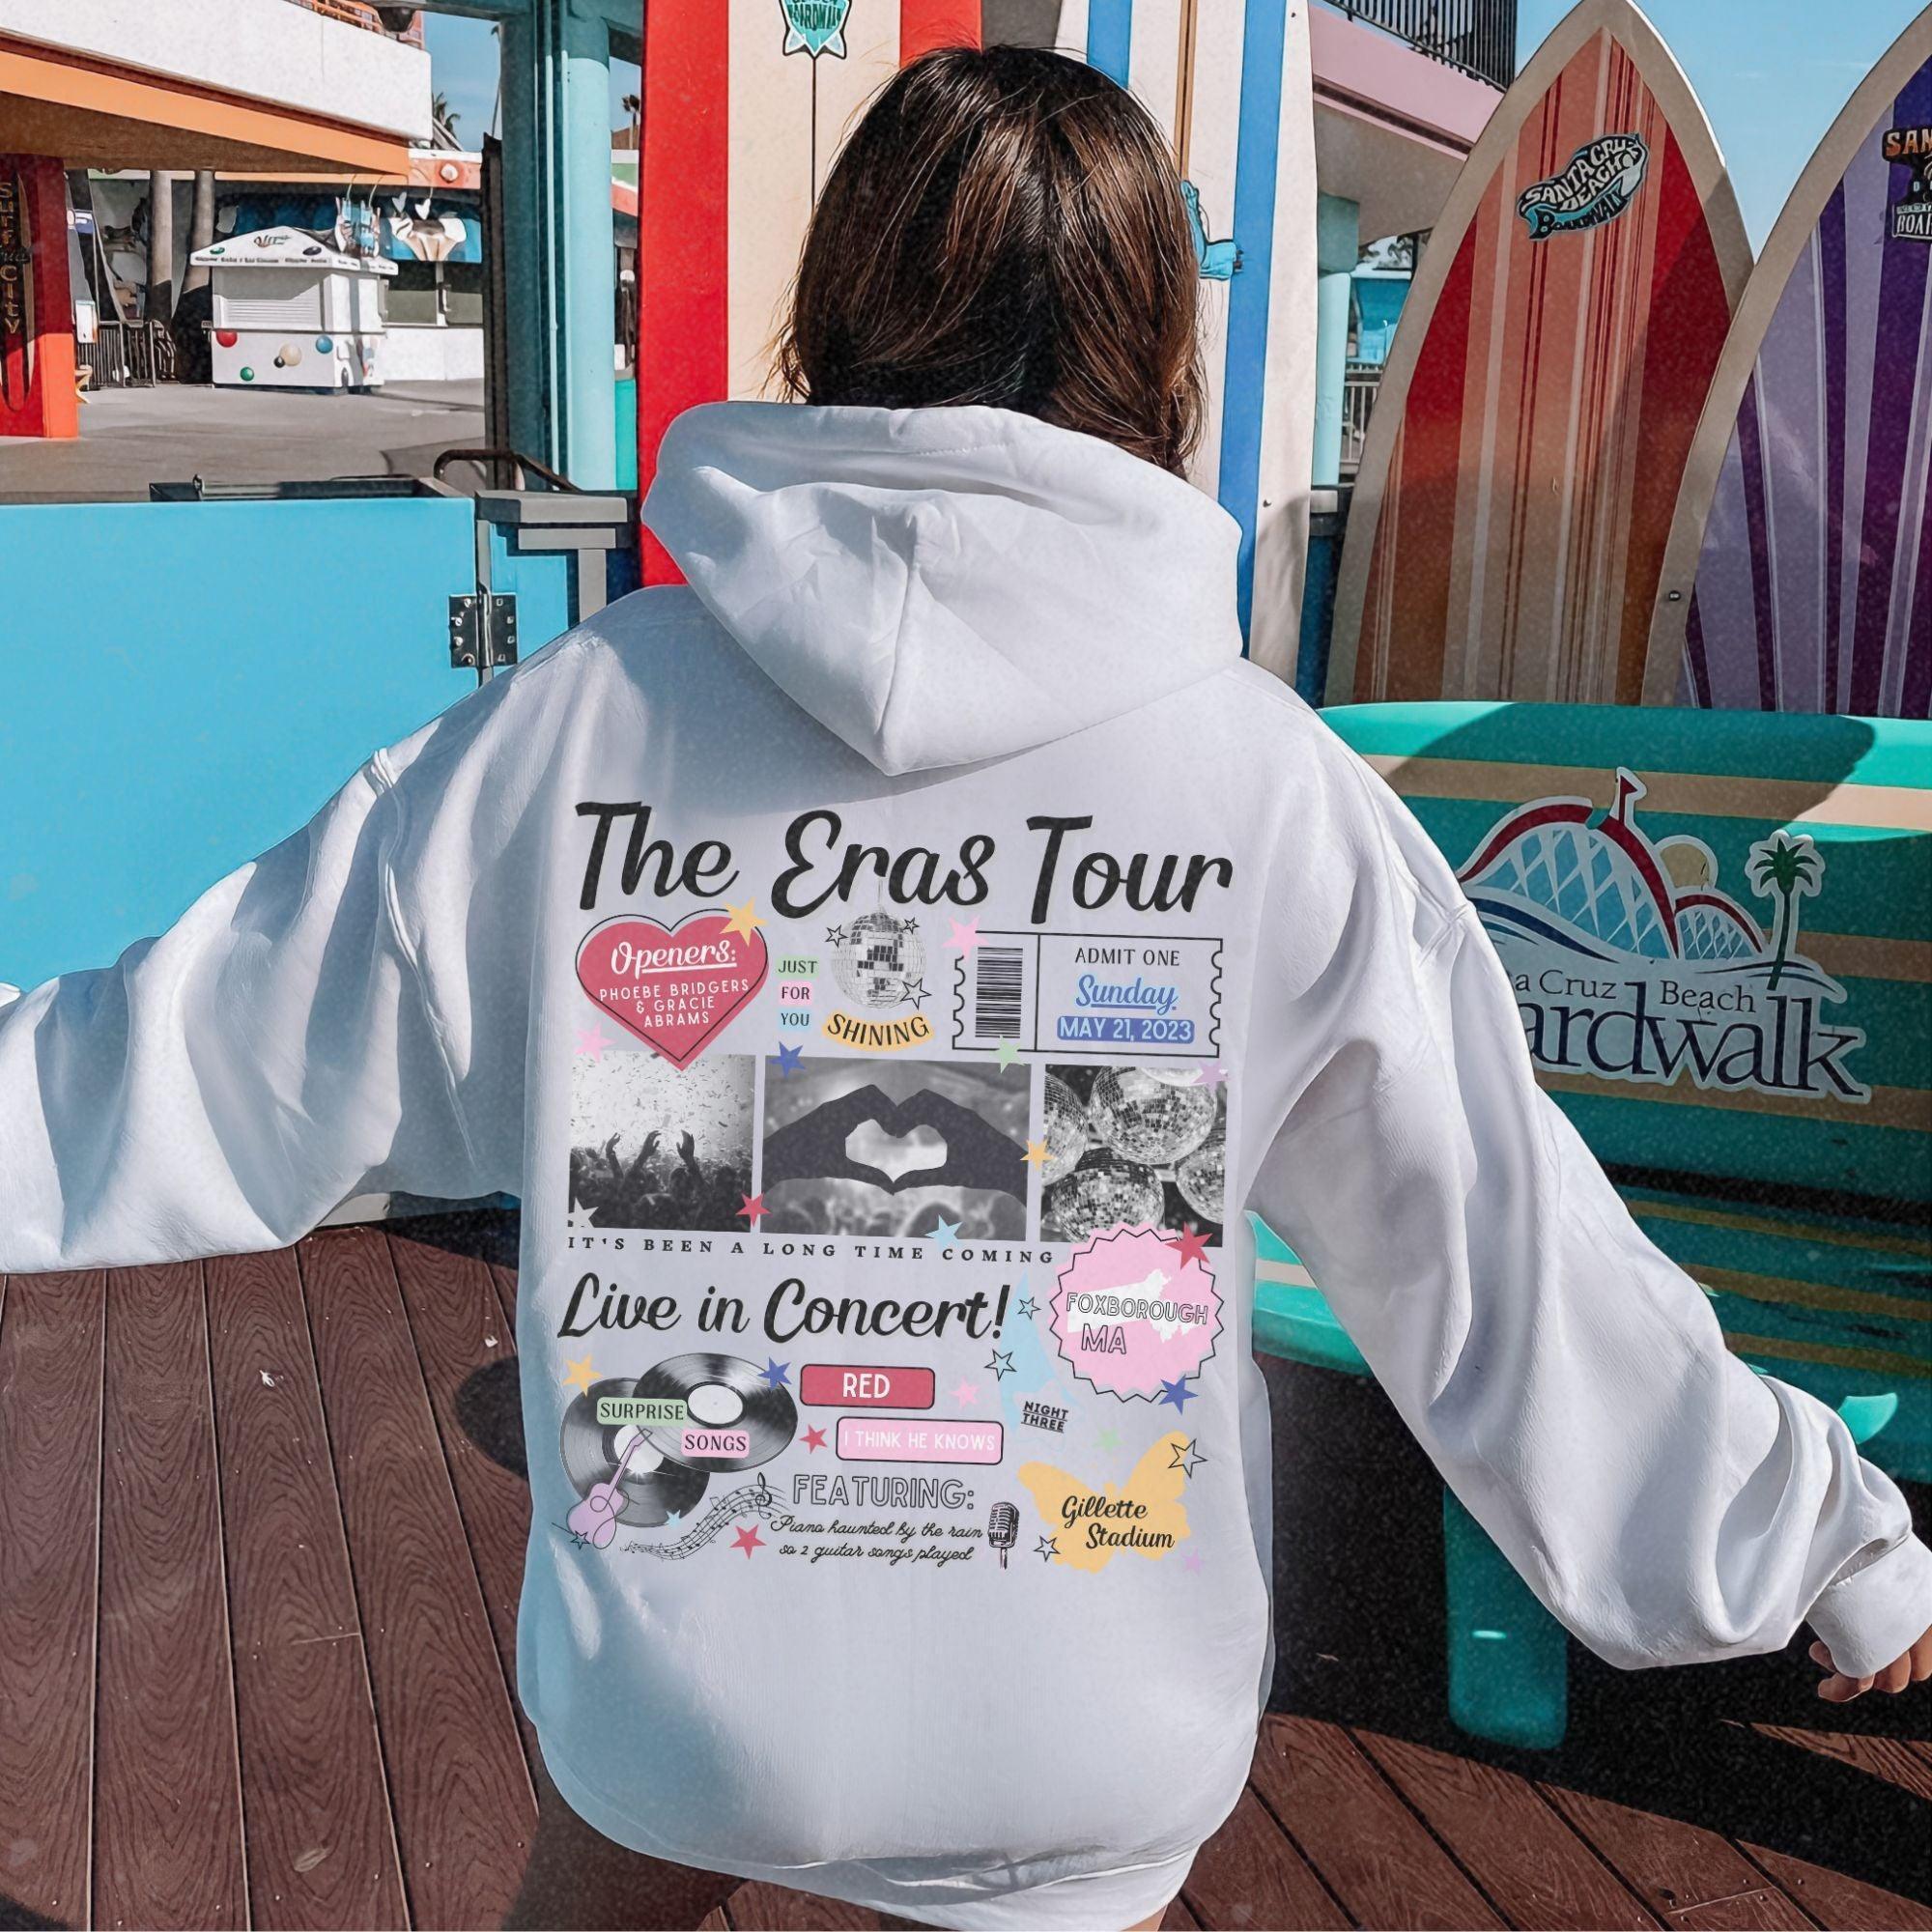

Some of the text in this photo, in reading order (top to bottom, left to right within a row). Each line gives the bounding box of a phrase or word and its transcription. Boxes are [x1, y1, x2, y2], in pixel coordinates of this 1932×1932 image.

[1521, 158, 1596, 212] SANTA
[575, 801, 1234, 924] The Eras Tour
[611, 939, 738, 980] Openers:
[778, 959, 817, 974] JUST
[1074, 948, 1180, 966] ADMIT ONE
[599, 979, 750, 1002] PHOEBE BRIDGERS
[781, 986, 810, 1001] FOR
[1075, 974, 1179, 1015] Sunday
[1539, 969, 1617, 1000] Cruz
[1661, 980, 1756, 1013] Beach
[636, 995, 715, 1014] & GRACIE
[643, 1011, 710, 1029] ABRAMS
[780, 1013, 810, 1027] YOU
[826, 1013, 929, 1047] SHINING
[1059, 1017, 1192, 1042] MAY 21, 2023
[568, 1236, 1053, 1264] IT'S BEEN A LONG TIME COMING
[557, 1272, 1010, 1344] Live in Concert!
[1066, 1293, 1208, 1325] FOXBOROUGH
[1081, 1323, 1127, 1354] MA
[842, 1373, 891, 1399] RED
[600, 1403, 685, 1420] SURPRISE
[1021, 1413, 1065, 1434] THREE
[1023, 1401, 1069, 1420] NIGHT
[684, 1434, 747, 1452] SONGS
[844, 1431, 996, 1451] I THINK HE KNOWS
[793, 1474, 975, 1510] FEATURING:
[1062, 1496, 1149, 1529] Gillette
[770, 1515, 983, 1544] Piano haunted by the rain
[1086, 1522, 1175, 1549] Stadium
[779, 1543, 975, 1568] so 2 guitar songs played
